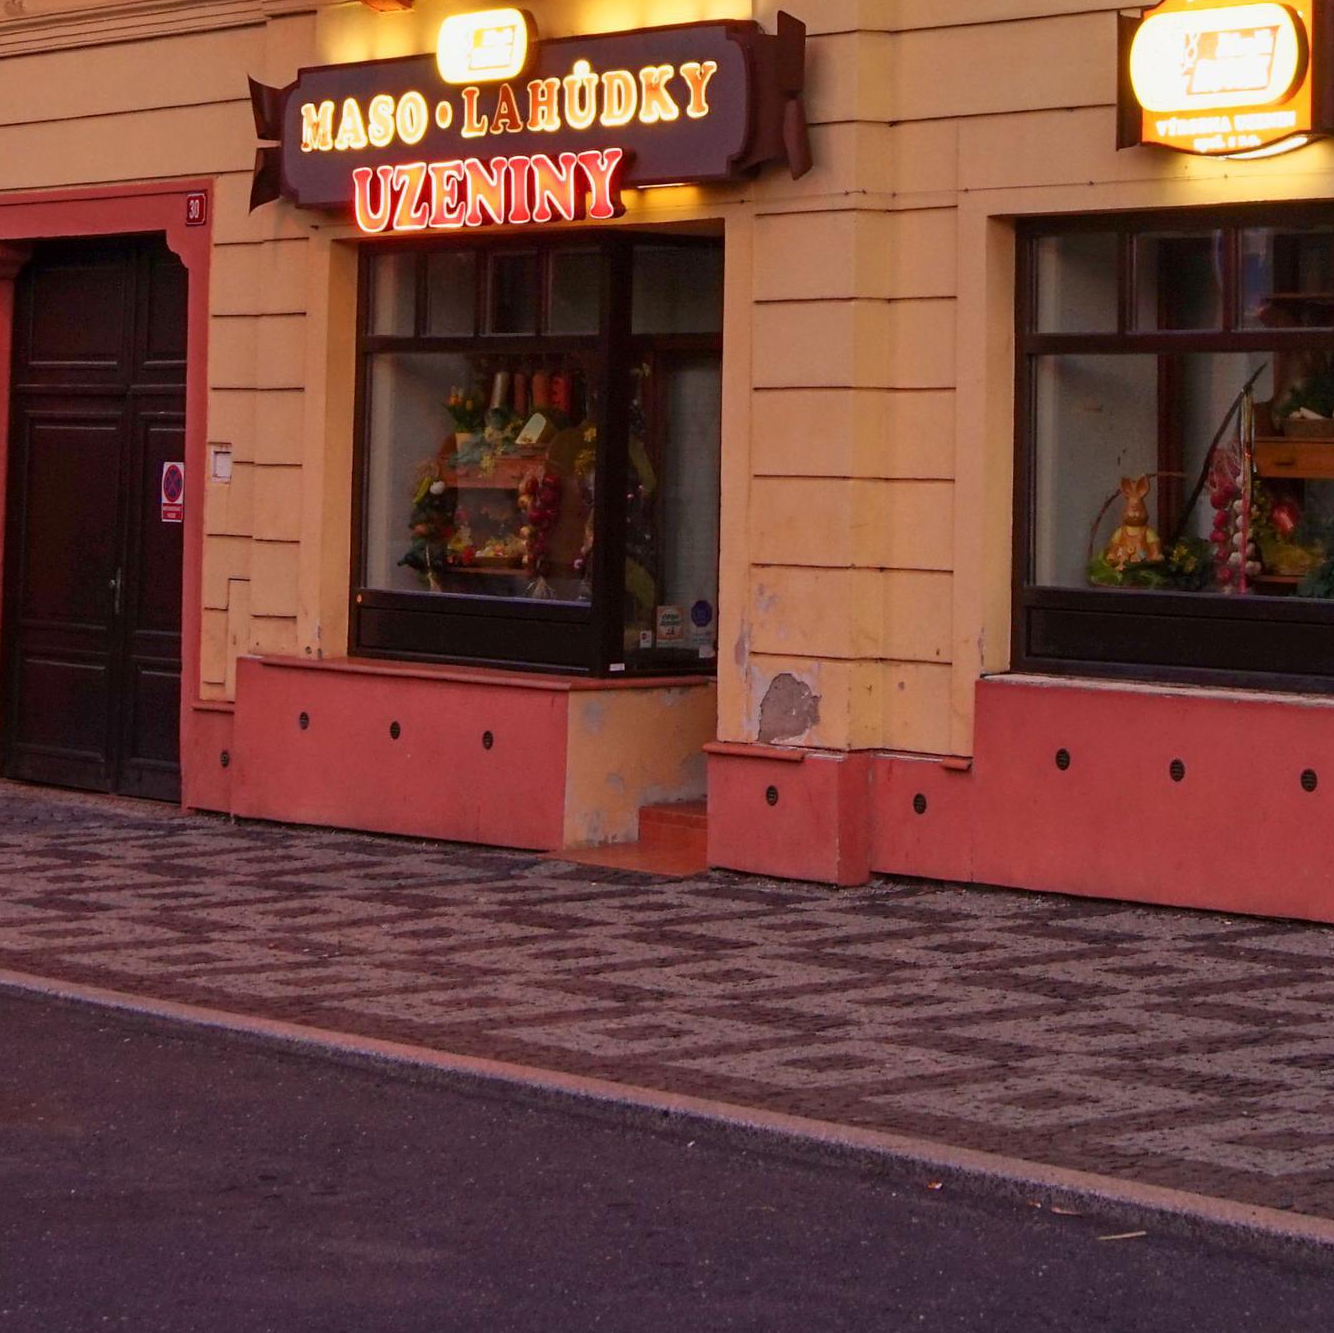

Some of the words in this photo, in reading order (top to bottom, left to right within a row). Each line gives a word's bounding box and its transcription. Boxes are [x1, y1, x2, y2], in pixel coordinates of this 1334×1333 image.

[301, 91, 429, 152] MASO
[461, 59, 718, 138] LAHŮDKY
[189, 199, 200, 219] 30
[353, 148, 623, 233] UZENINY
